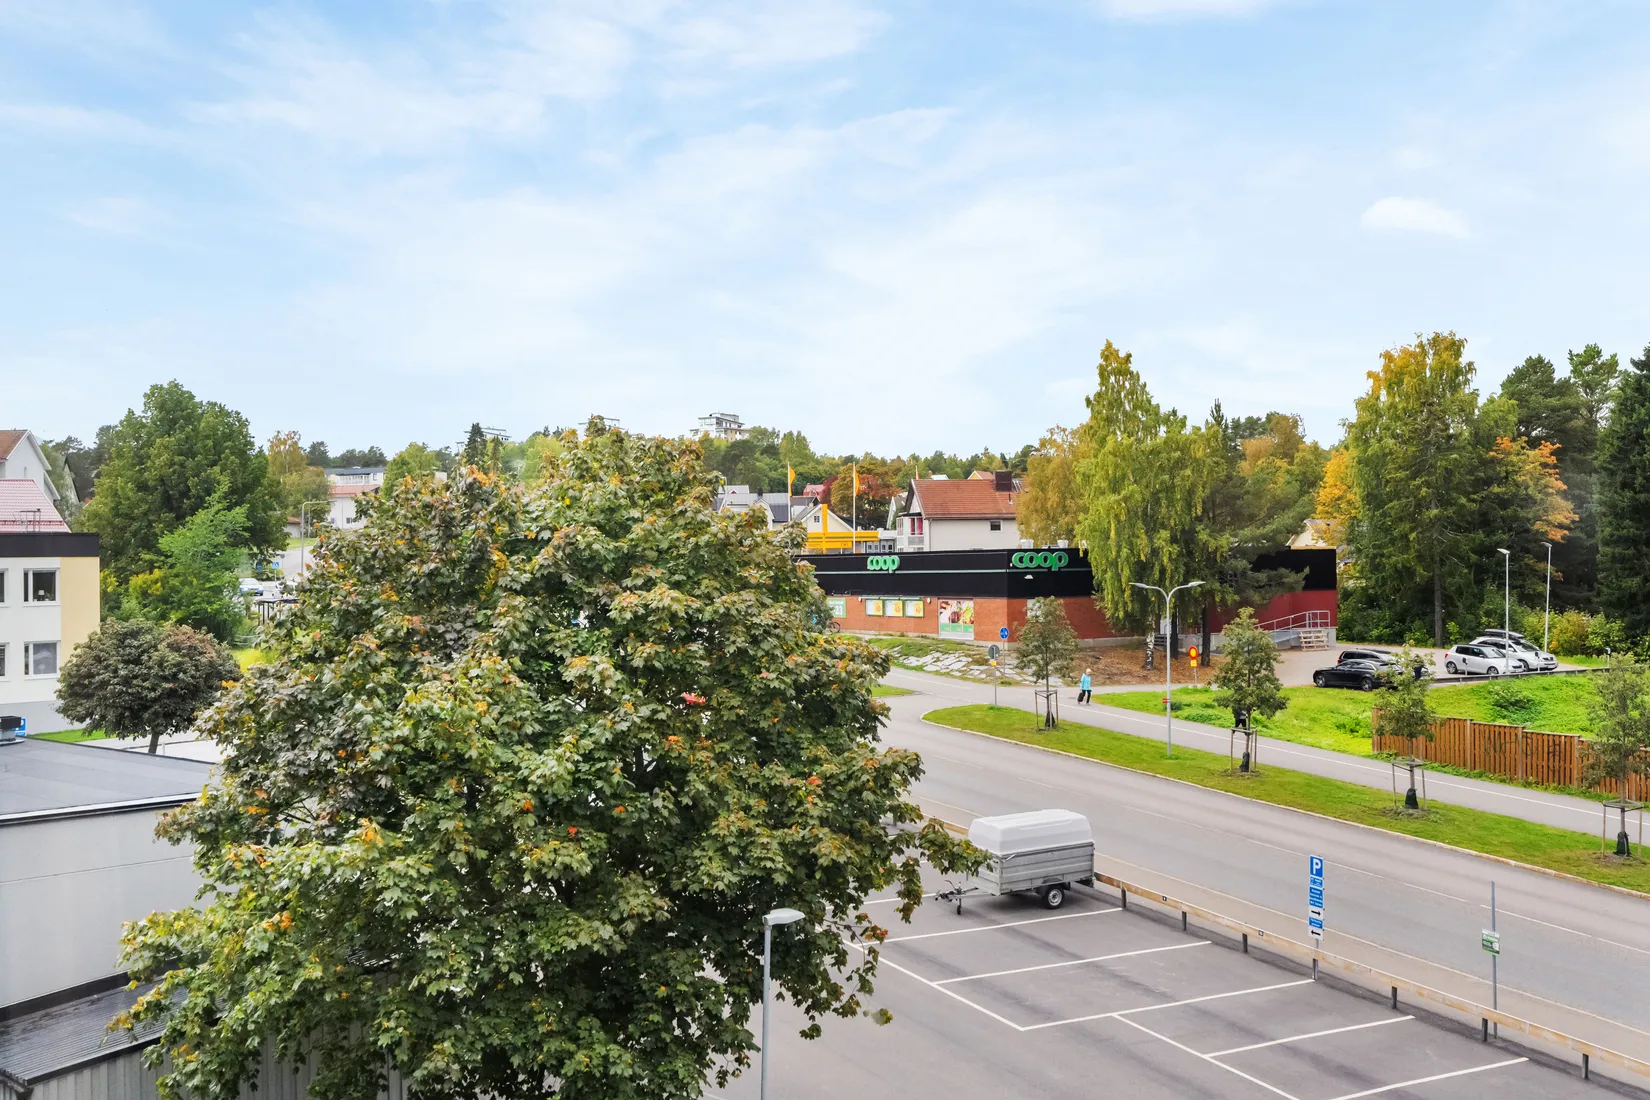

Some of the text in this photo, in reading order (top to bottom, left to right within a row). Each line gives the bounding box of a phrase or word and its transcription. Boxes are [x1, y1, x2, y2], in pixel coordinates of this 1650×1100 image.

[867, 555, 900, 573] coop
[1012, 552, 1068, 571] coop
[1313, 858, 1321, 875] P
